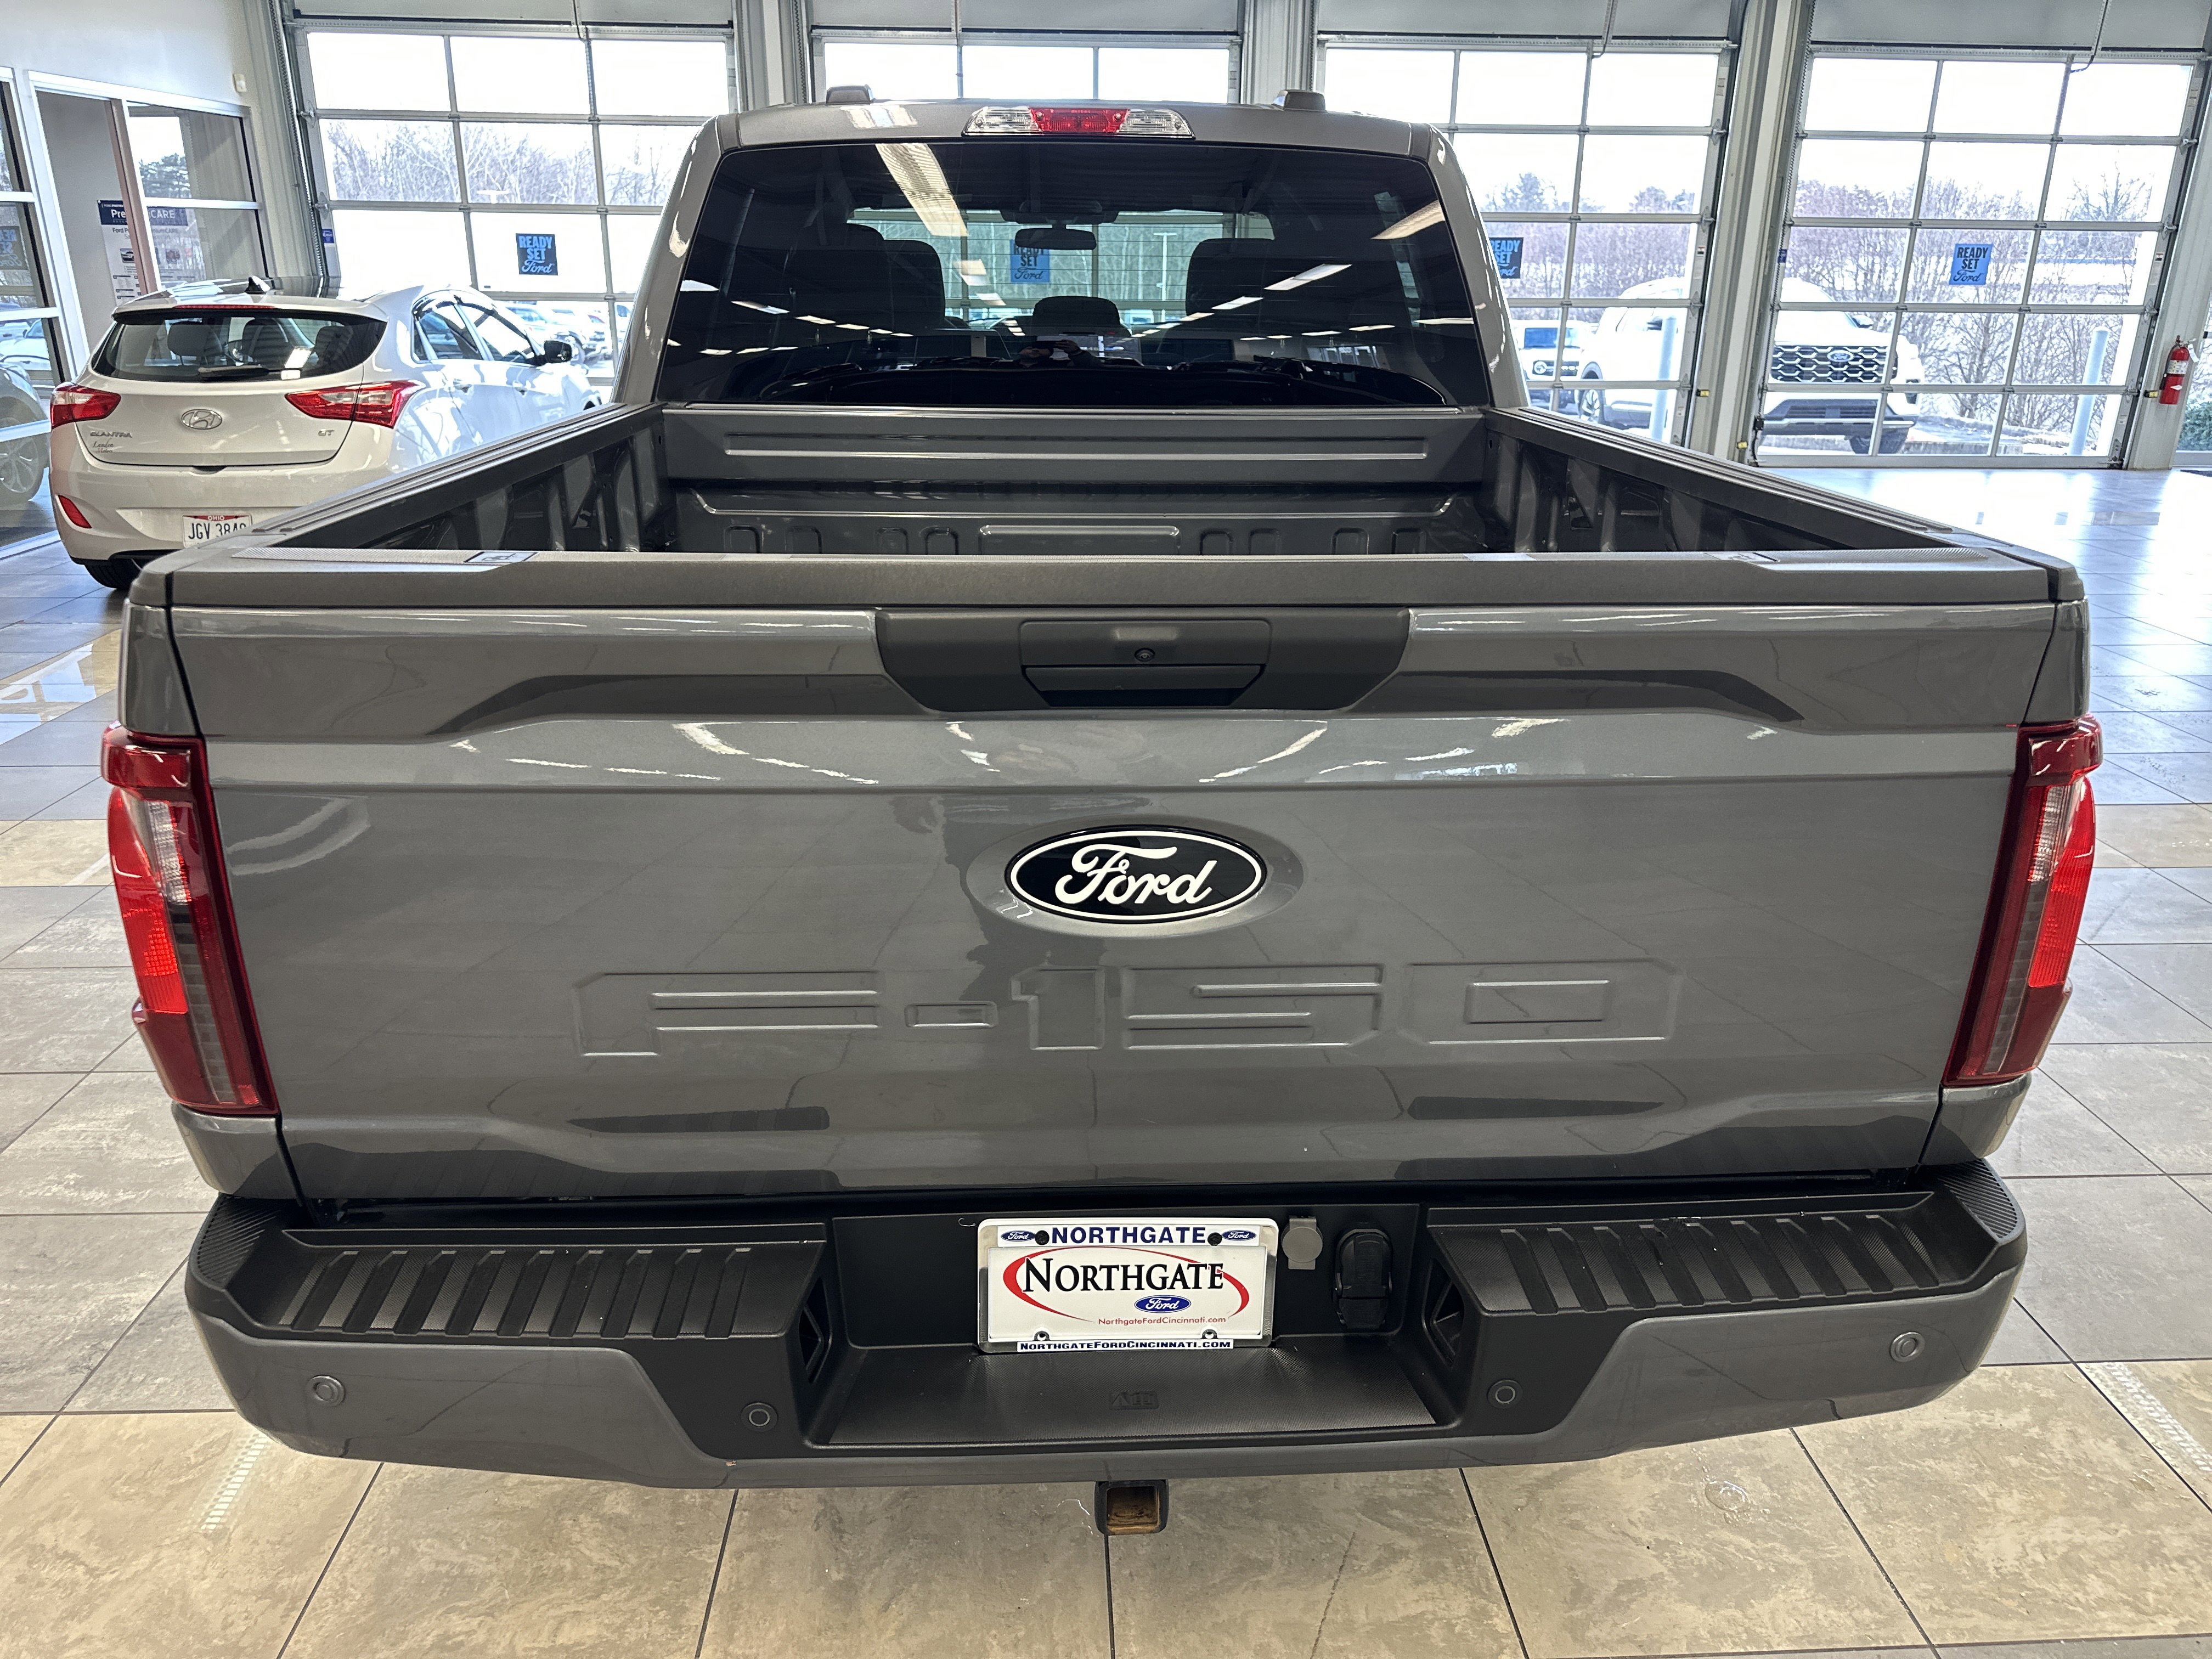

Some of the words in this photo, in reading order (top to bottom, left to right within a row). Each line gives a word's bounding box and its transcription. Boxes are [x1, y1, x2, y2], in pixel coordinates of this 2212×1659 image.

[518, 236, 552, 249] READY
[527, 248, 546, 259] SET
[1957, 247, 1989, 258] READY
[521, 259, 555, 273] Ford
[1020, 255, 1037, 267] SET
[1961, 258, 1979, 269] SET
[1014, 267, 1045, 279] Ford
[1953, 269, 1984, 282] Ford
[188, 523, 210, 539] JGV
[1055, 844, 1217, 904] Ford
[573, 960, 1681, 1056] F-150
[1007, 1231, 1029, 1240] Ford
[1052, 1226, 1206, 1244] NORTHGATE
[1228, 1231, 1250, 1239] Ford
[1023, 1258, 1224, 1292] NORTHGATE
[1145, 1297, 1180, 1310] Ford
[1098, 1317, 1226, 1326] NorthgateFordCincinnati.com
